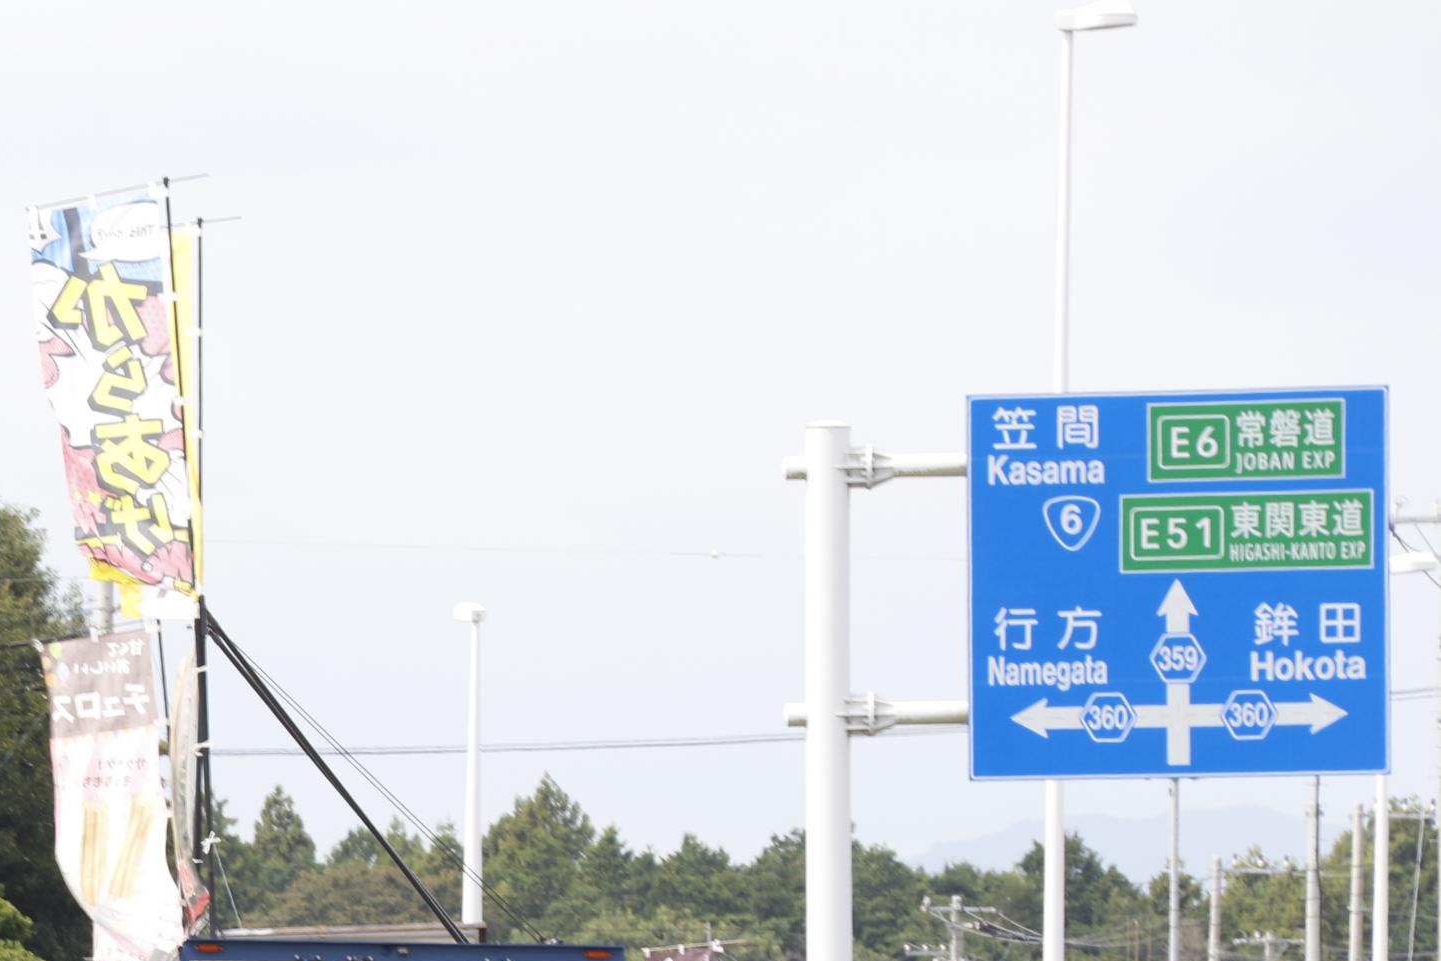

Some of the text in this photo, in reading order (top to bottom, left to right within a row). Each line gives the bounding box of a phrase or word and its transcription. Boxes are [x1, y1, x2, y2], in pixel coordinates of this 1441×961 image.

[992, 404, 1100, 451] 笠間
[1170, 425, 1220, 459] E6
[1235, 408, 1336, 449] 常磐道
[987, 454, 1105, 486] Kasama
[1235, 450, 1336, 474] JOBAN EXP
[1060, 508, 1083, 535] 6
[1140, 516, 1214, 550] E51
[1228, 500, 1365, 540] 東関東道
[1229, 540, 1367, 563] HIGASHI-KANTO EXP
[993, 606, 1103, 651] 行方
[1253, 602, 1362, 648] 鉾田
[987, 655, 1109, 692] Namegata
[1156, 644, 1199, 671] 359
[1249, 650, 1367, 682] Hokota
[1087, 704, 1127, 731] 360
[1229, 702, 1268, 728] 360
